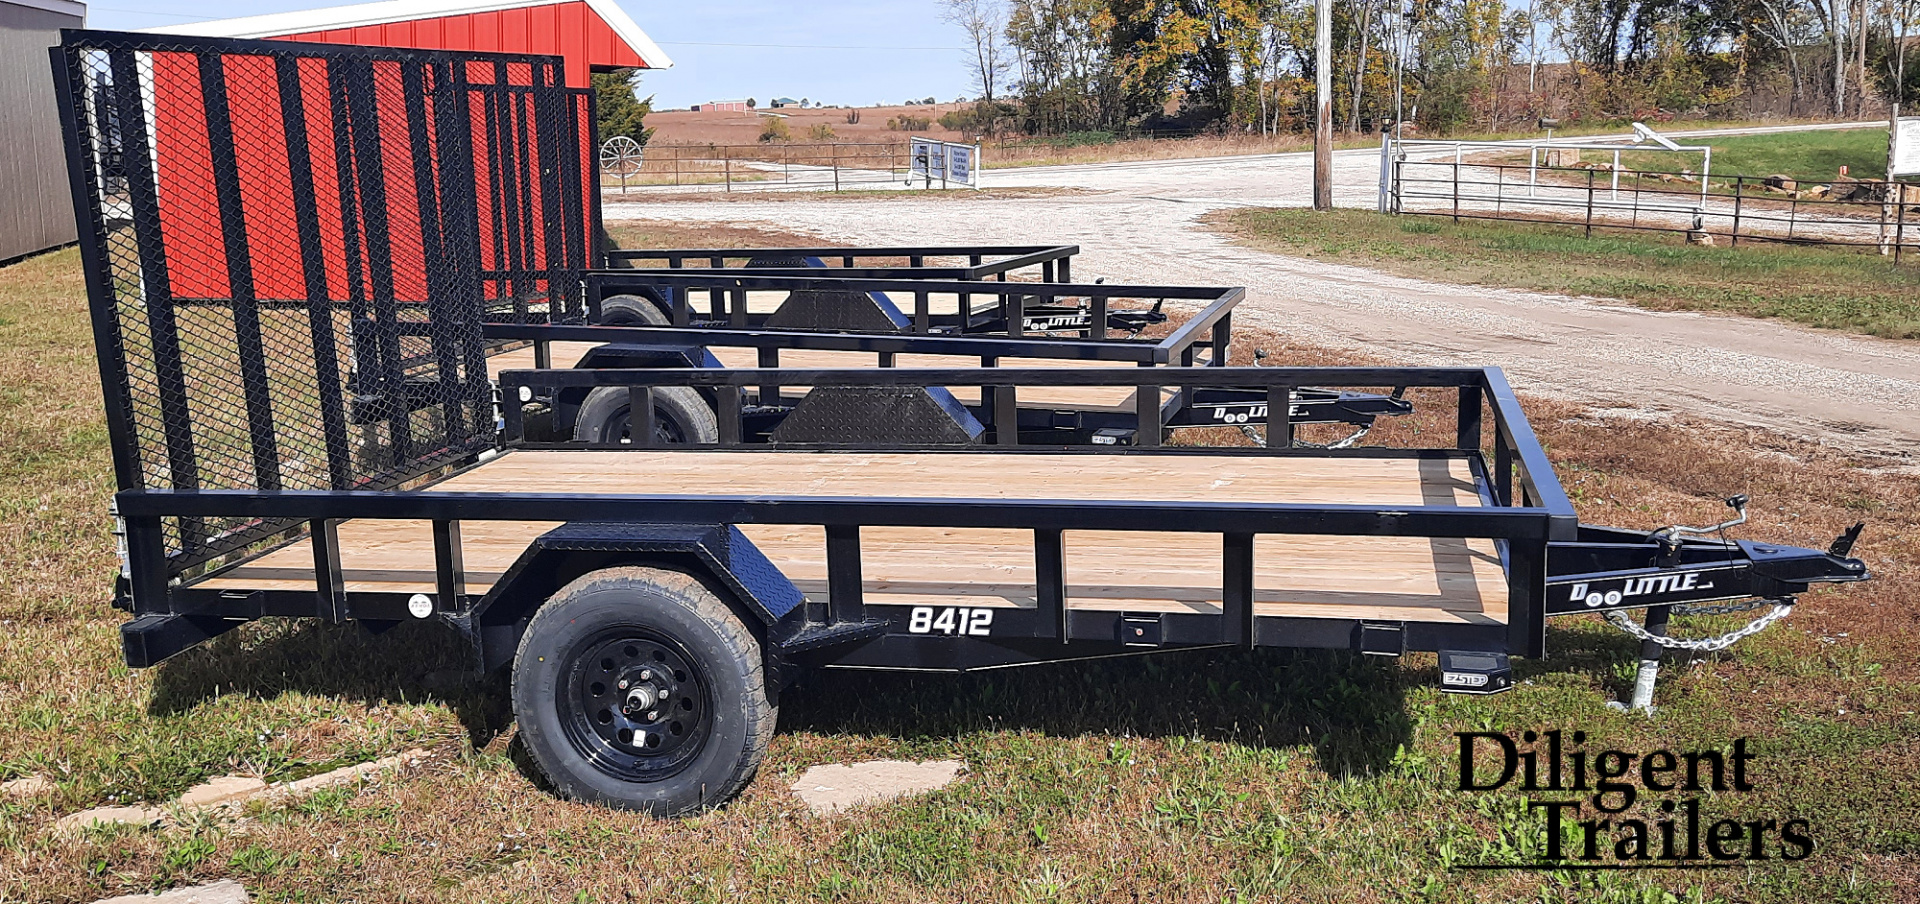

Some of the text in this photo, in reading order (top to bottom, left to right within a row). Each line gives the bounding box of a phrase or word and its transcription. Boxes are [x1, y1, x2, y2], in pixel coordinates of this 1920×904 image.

[1213, 405, 1299, 423] DOOLITE
[1570, 573, 1700, 607] DOOLITTLE
[909, 606, 993, 636] 8412
